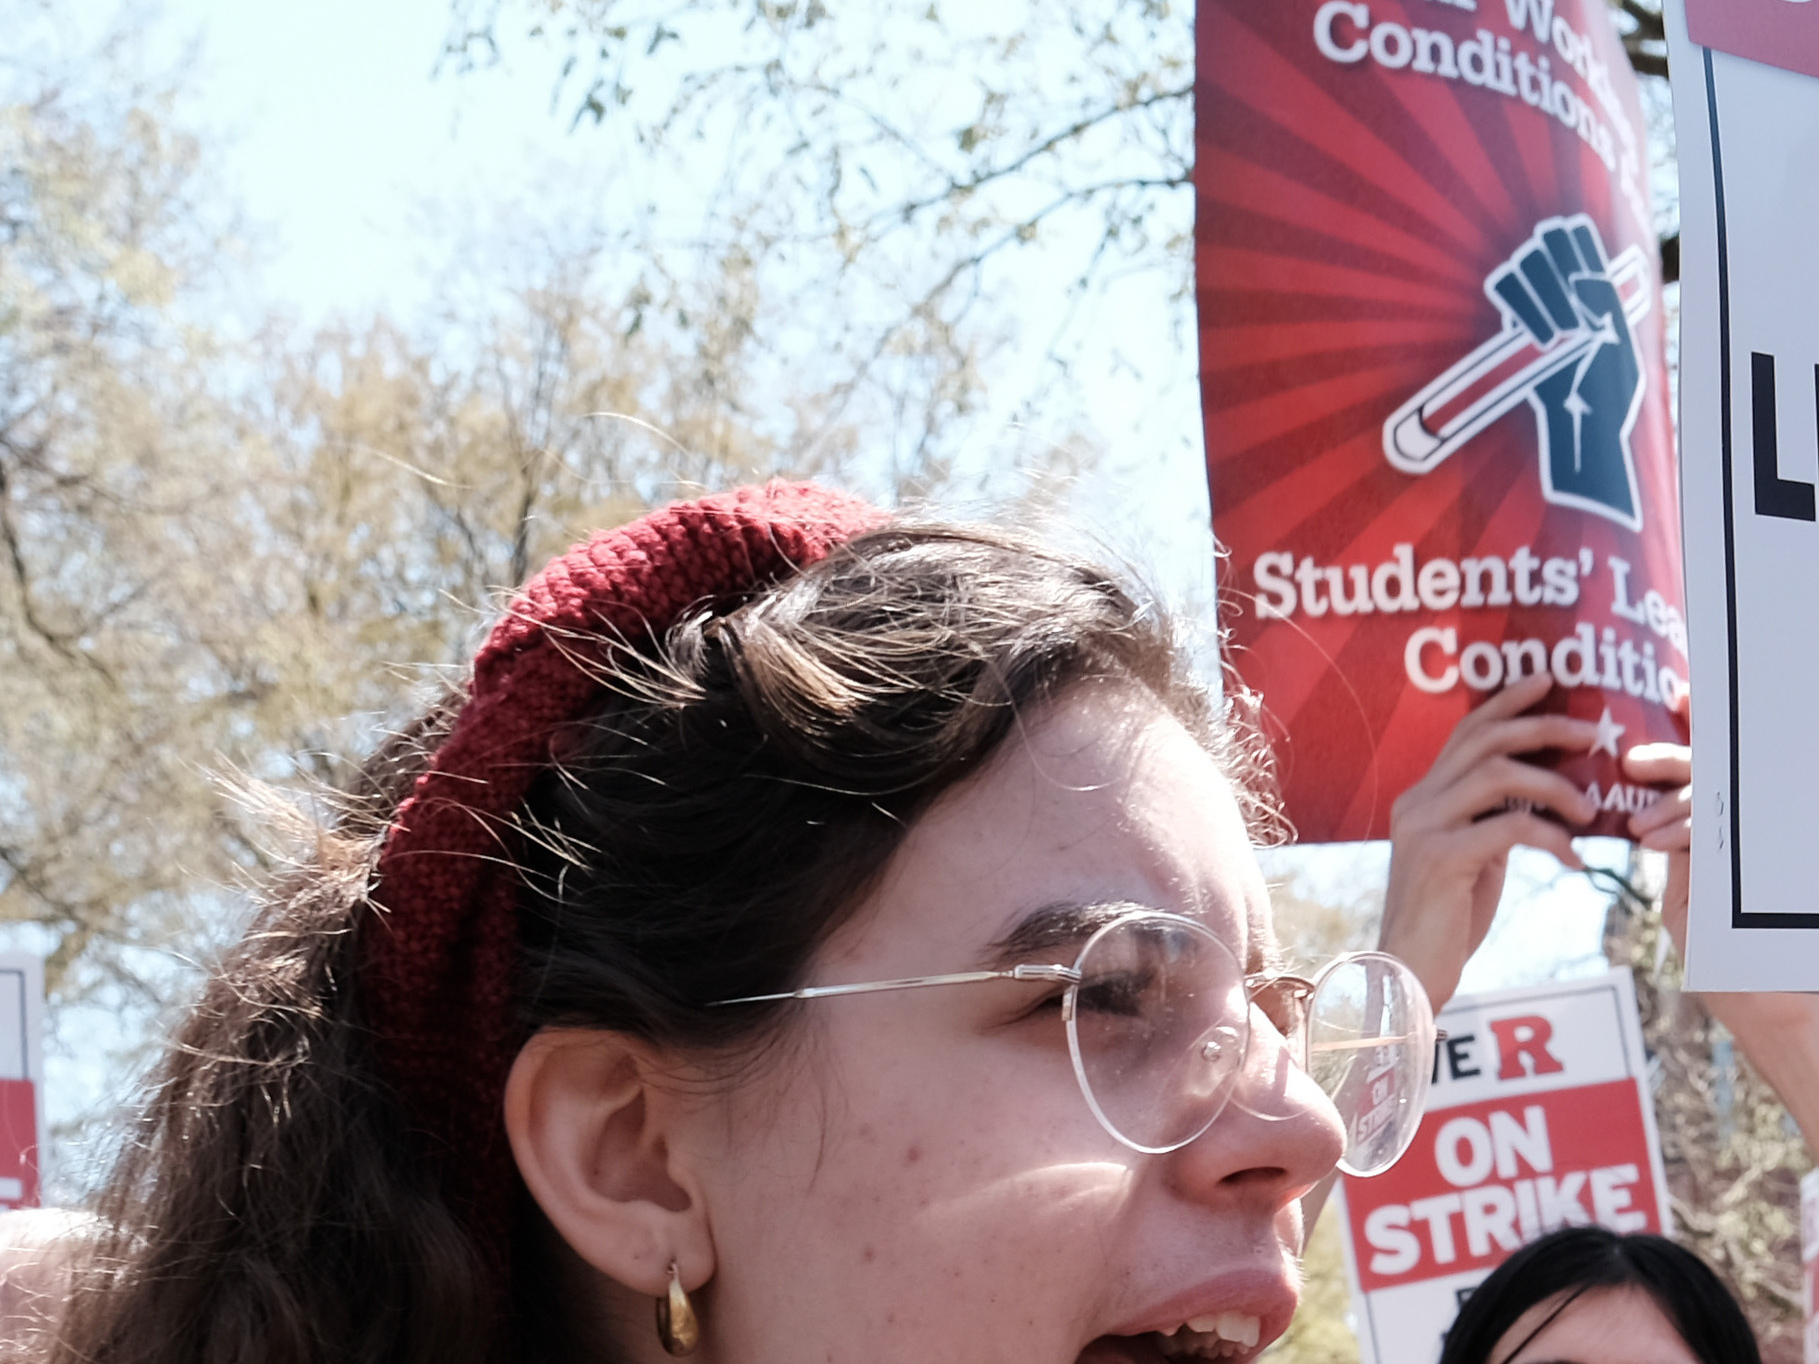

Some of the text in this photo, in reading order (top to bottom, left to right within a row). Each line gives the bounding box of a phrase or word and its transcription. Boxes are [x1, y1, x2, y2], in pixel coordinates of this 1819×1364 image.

[1254, 543, 1592, 619] Students'
[1405, 624, 1687, 711] Conditio
[1431, 1014, 1563, 1085] E R
[1434, 1105, 1553, 1188] ON
[1363, 1163, 1646, 1276] STRIKE
